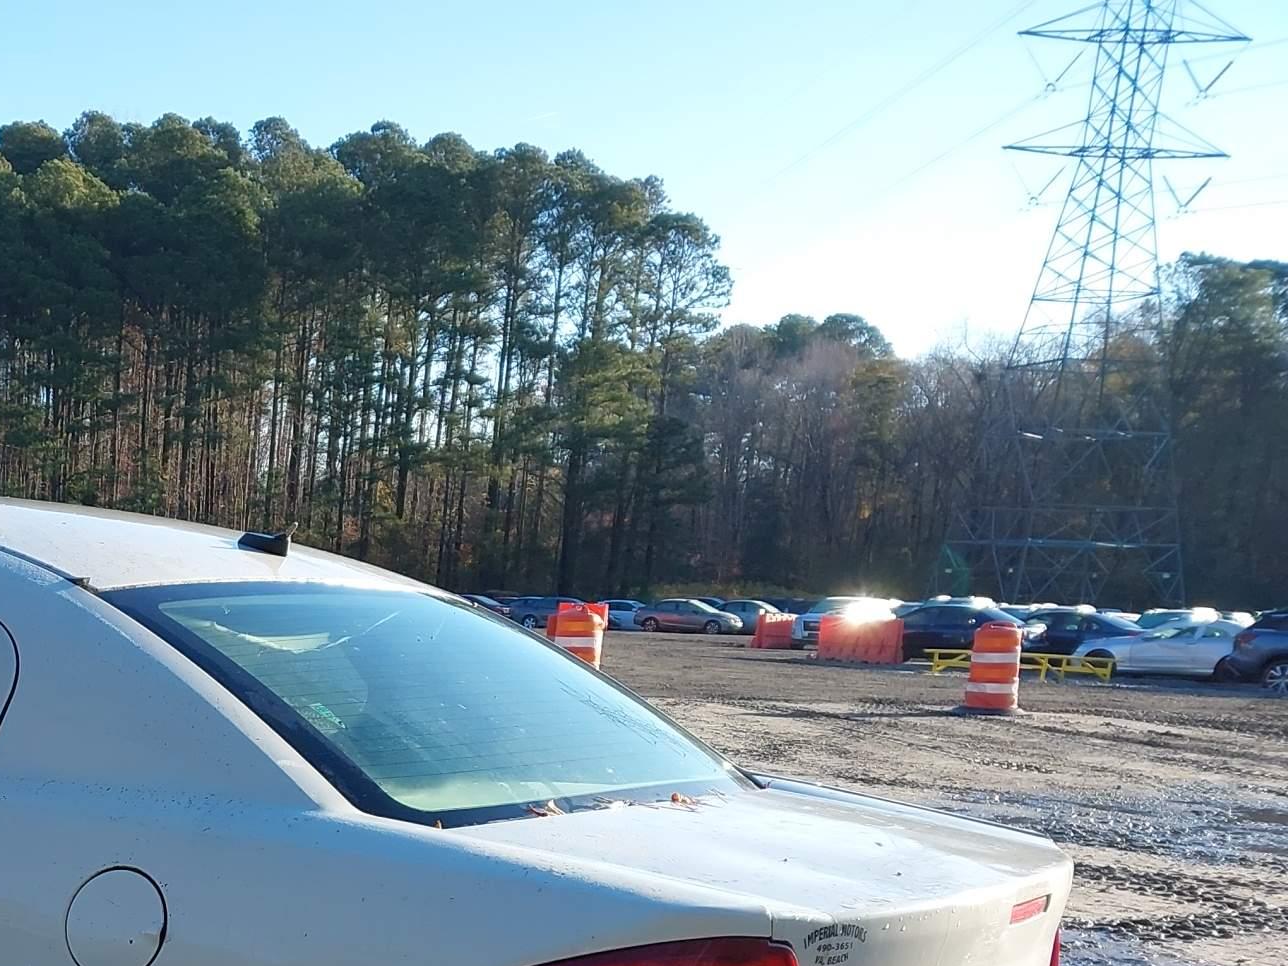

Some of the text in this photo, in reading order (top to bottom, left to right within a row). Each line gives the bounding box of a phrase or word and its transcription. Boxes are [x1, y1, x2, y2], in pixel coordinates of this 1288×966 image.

[803, 923, 868, 950] IMPERIAL MOTORS
[816, 942, 853, 952] 490-3651
[826, 952, 849, 965] BEACH
